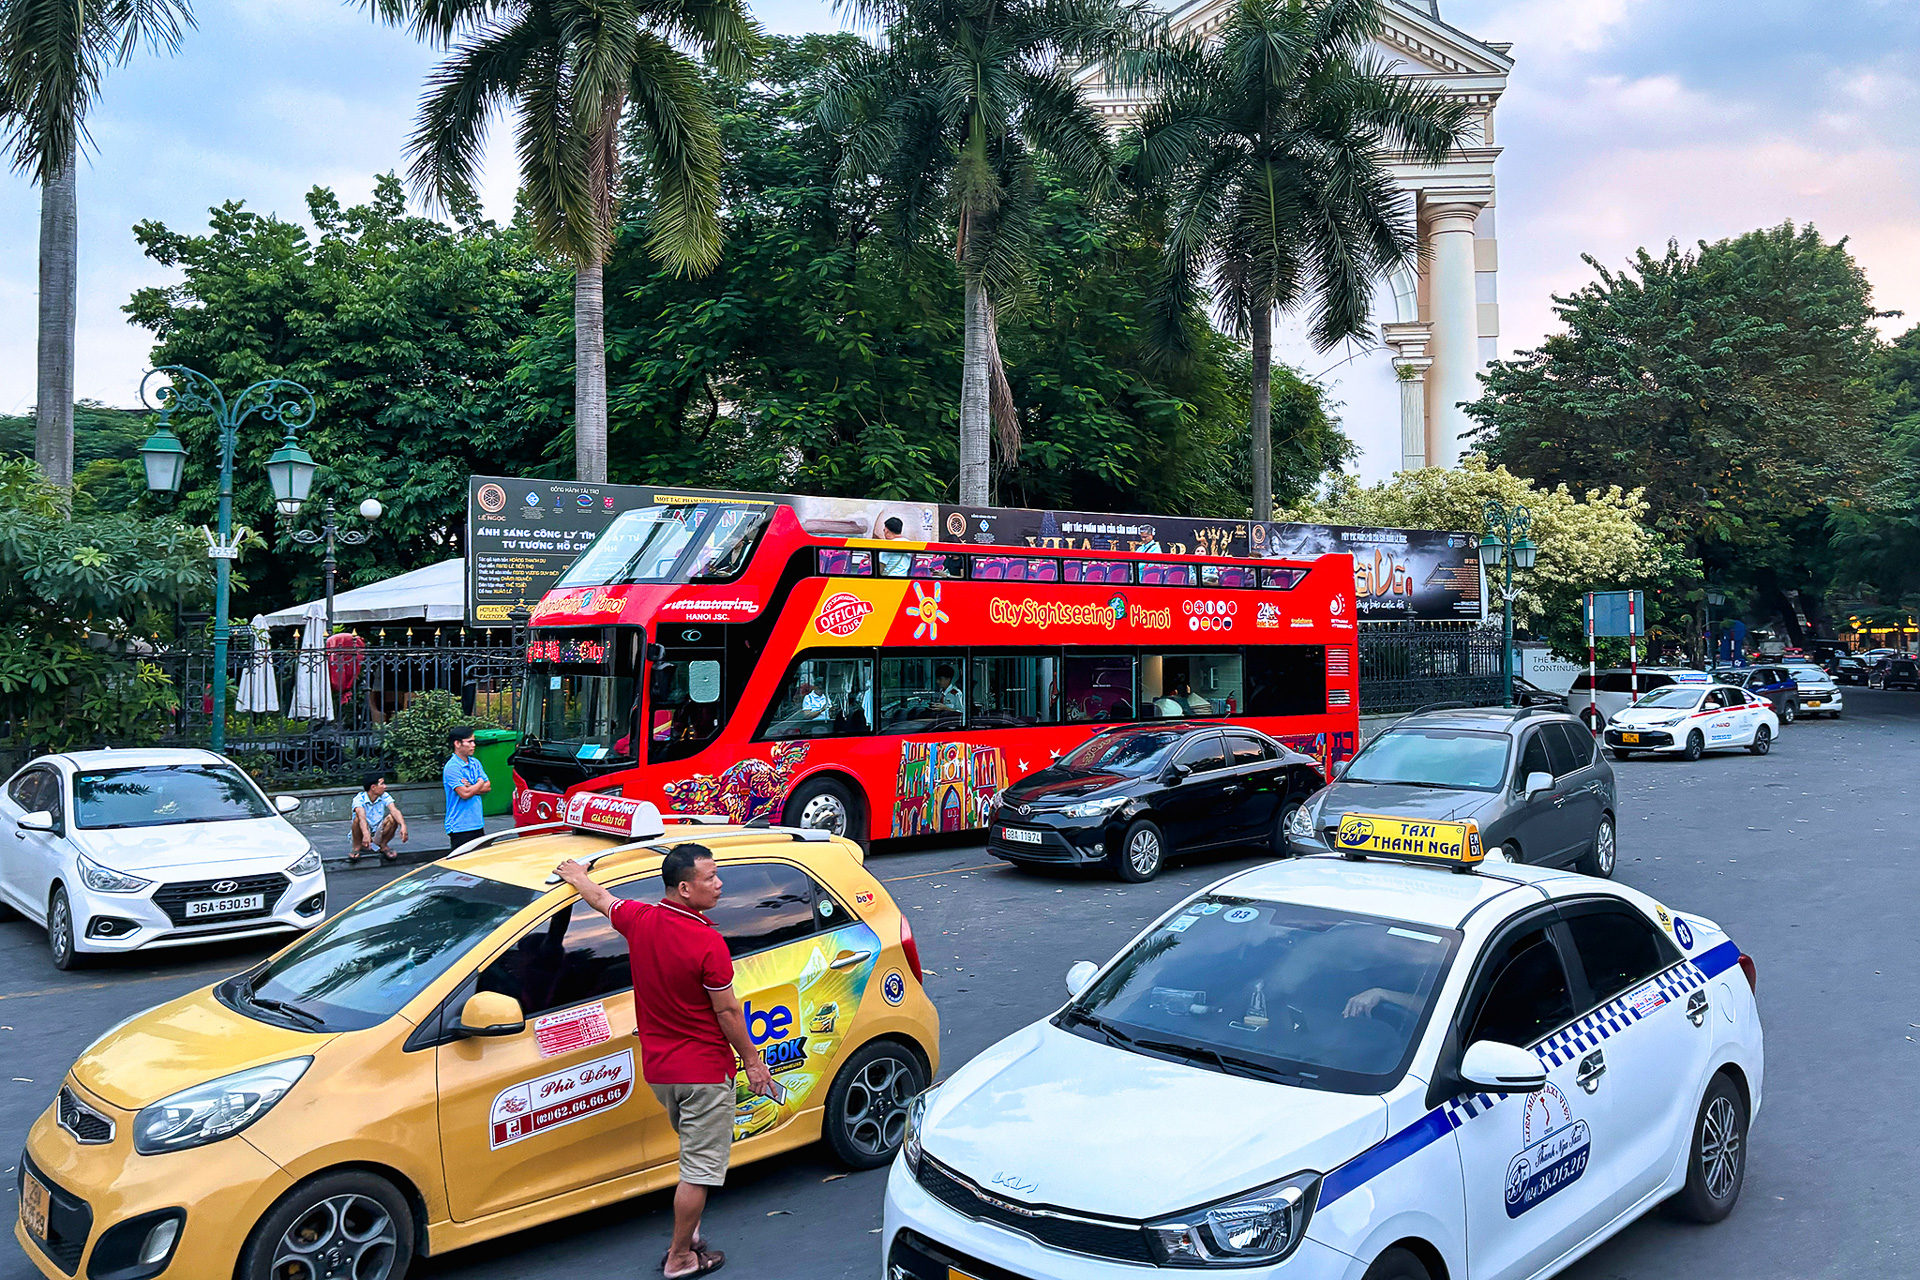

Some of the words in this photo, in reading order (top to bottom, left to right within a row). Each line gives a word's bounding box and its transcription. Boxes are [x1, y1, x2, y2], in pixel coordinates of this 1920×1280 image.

[820, 603, 871, 629] OFFICIAL
[838, 619, 861, 634] TOUR
[1130, 604, 1171, 628] Hanoi
[1401, 823, 1436, 838] TAXI
[1372, 835, 1424, 852] THANH
[1428, 841, 1460, 857] NGA
[743, 1000, 793, 1045] be
[767, 1037, 802, 1067] 50K
